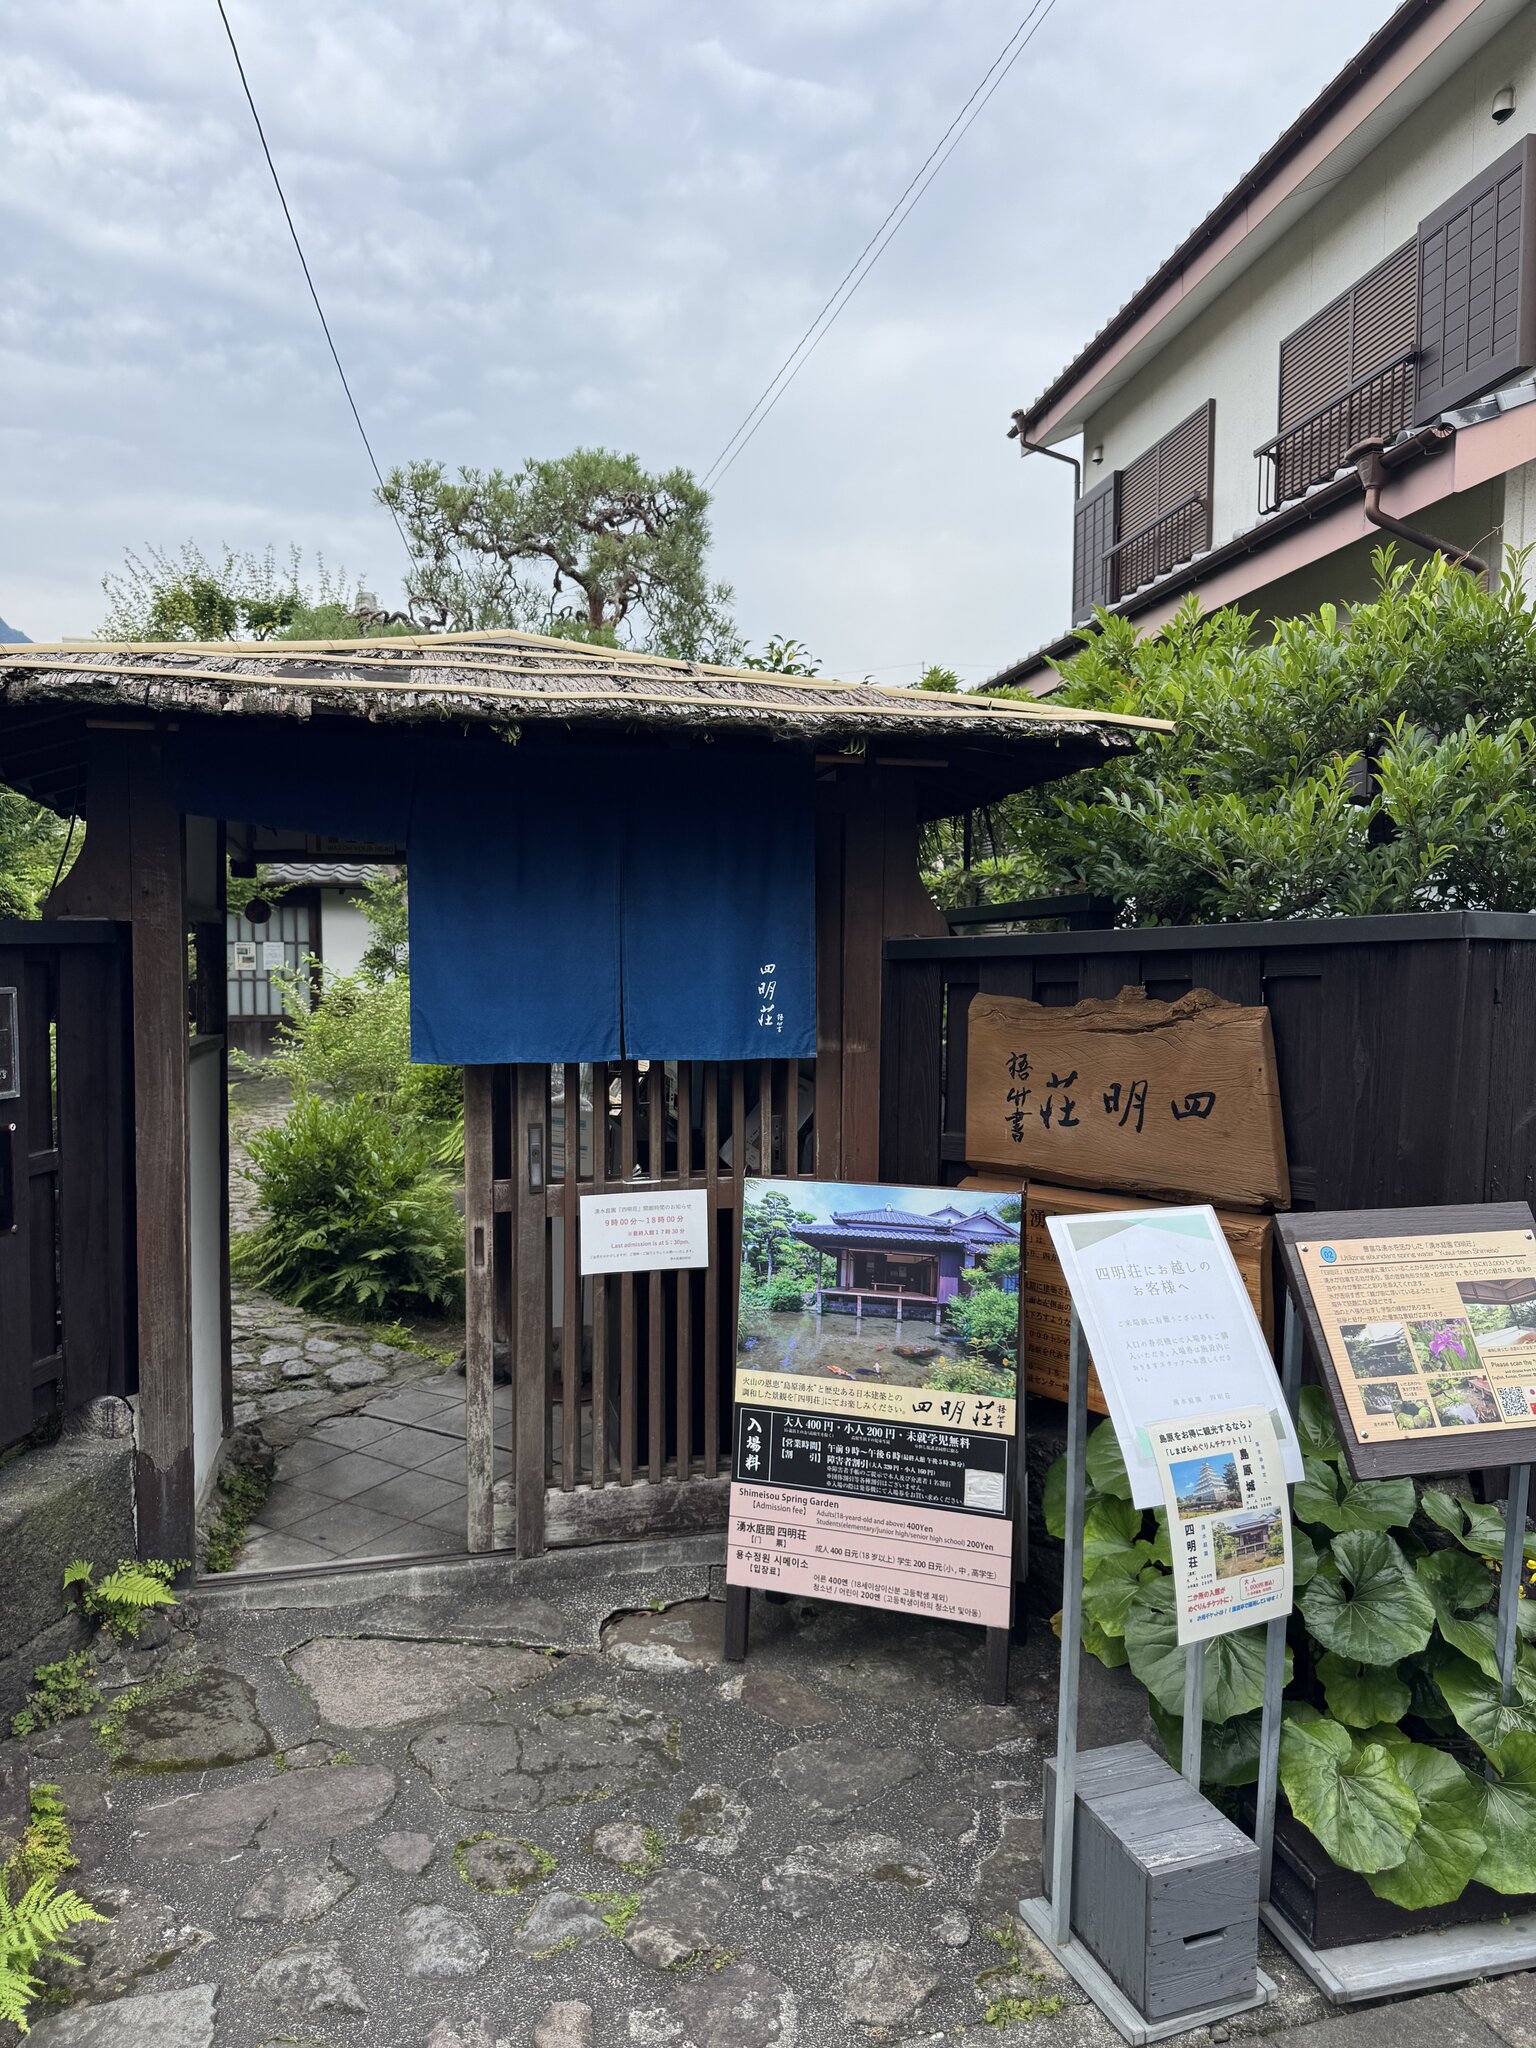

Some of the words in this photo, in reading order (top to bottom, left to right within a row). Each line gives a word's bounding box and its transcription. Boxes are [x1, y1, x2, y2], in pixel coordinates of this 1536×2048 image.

[758, 964, 776, 1026] 四明荘
[1040, 1070, 1216, 1133] 四明荘
[624, 1240, 652, 1248] admission
[1324, 1250, 1334, 1259] 02
[1397, 1252, 1417, 1260] spring
[1095, 1260, 1210, 1281] 四明荘にお越しの
[1133, 1280, 1190, 1297] お客様へ
[742, 1388, 906, 1415] 調和した景観を「四明荘」にてお楽しみください。
[912, 1400, 995, 1427] 四明荘
[745, 1417, 763, 1472] 入場料
[781, 1437, 822, 1452] 【営業時間】
[1240, 1448, 1256, 1493] 島原城
[739, 1488, 780, 1501] Shimeisou
[781, 1493, 808, 1506] Spring
[809, 1497, 839, 1509] Garden
[872, 1517, 885, 1525] and
[885, 1519, 906, 1529] above)
[906, 1522, 933, 1533] 400Yen
[894, 1528, 929, 1541] high/senior
[929, 1534, 944, 1545] high
[944, 1537, 966, 1547] school)
[966, 1540, 994, 1551] 200Yen
[1184, 1523, 1199, 1570] 四明荘
[736, 1549, 770, 1564] 용수정원
[774, 1555, 809, 1569] 시메이소
[813, 1583, 833, 1594] 청소년
